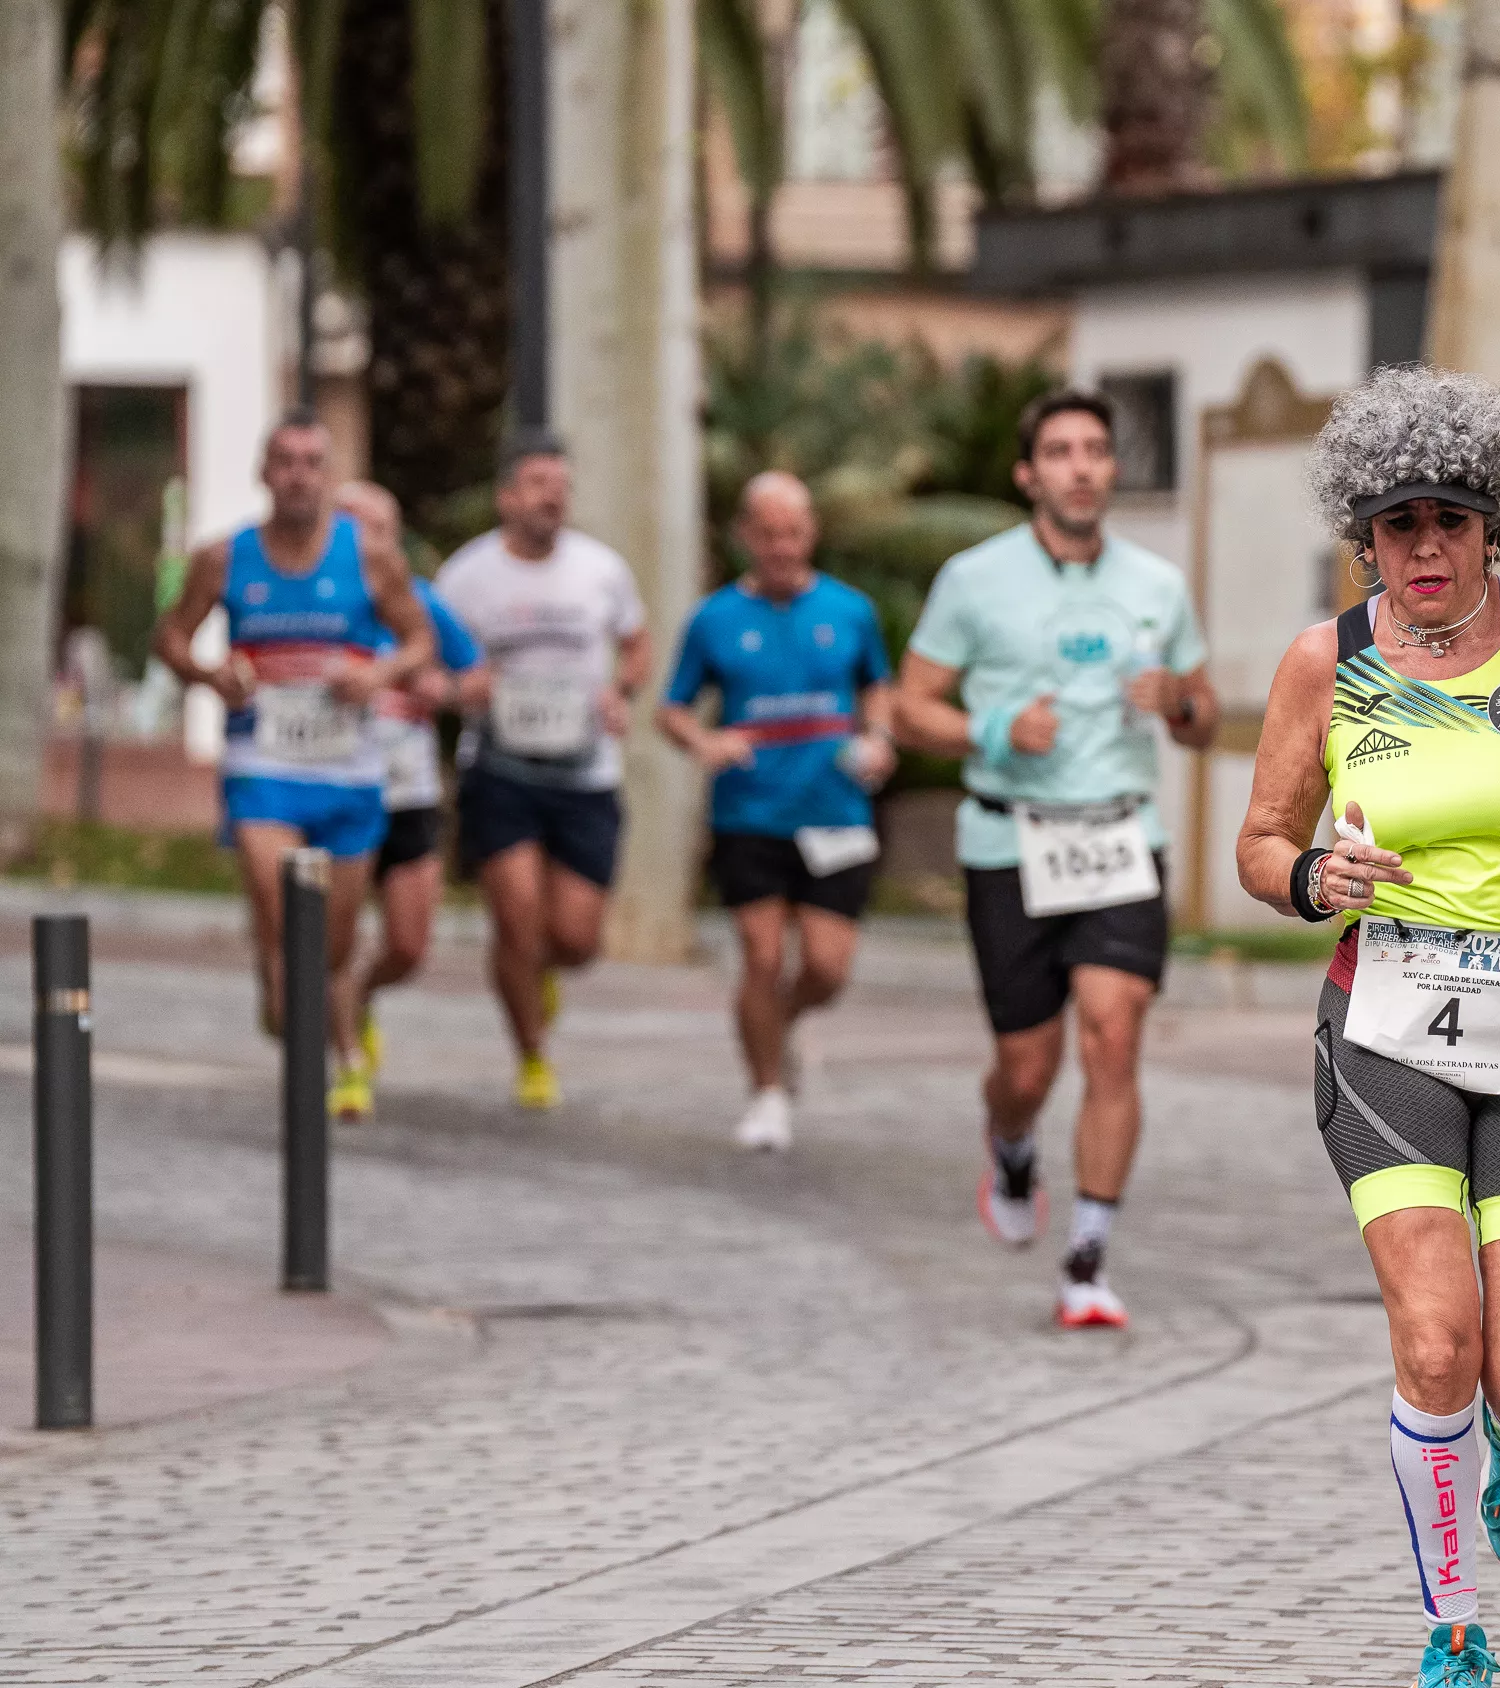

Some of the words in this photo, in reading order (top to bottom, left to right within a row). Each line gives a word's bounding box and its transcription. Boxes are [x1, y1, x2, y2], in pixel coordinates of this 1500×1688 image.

[1347, 749, 1410, 770] ESMONSUR
[1366, 923, 1400, 934] CIRCUIT
[1365, 940, 1407, 949] DIPUTACIÓN
[1411, 935, 1460, 950] POPULARES
[1418, 972, 1432, 980] C.P.
[1433, 974, 1460, 983] CIUDAD
[1472, 978, 1500, 987] LUCENA
[1417, 982, 1431, 990] POR
[1432, 983, 1442, 991] LA
[1444, 984, 1481, 994] IGUALDAD
[1427, 997, 1464, 1046] 4
[1415, 1058, 1435, 1067] JOSÉ
[1436, 1060, 1473, 1069] ESTRADA
[1475, 1061, 1499, 1070] RIVAS
